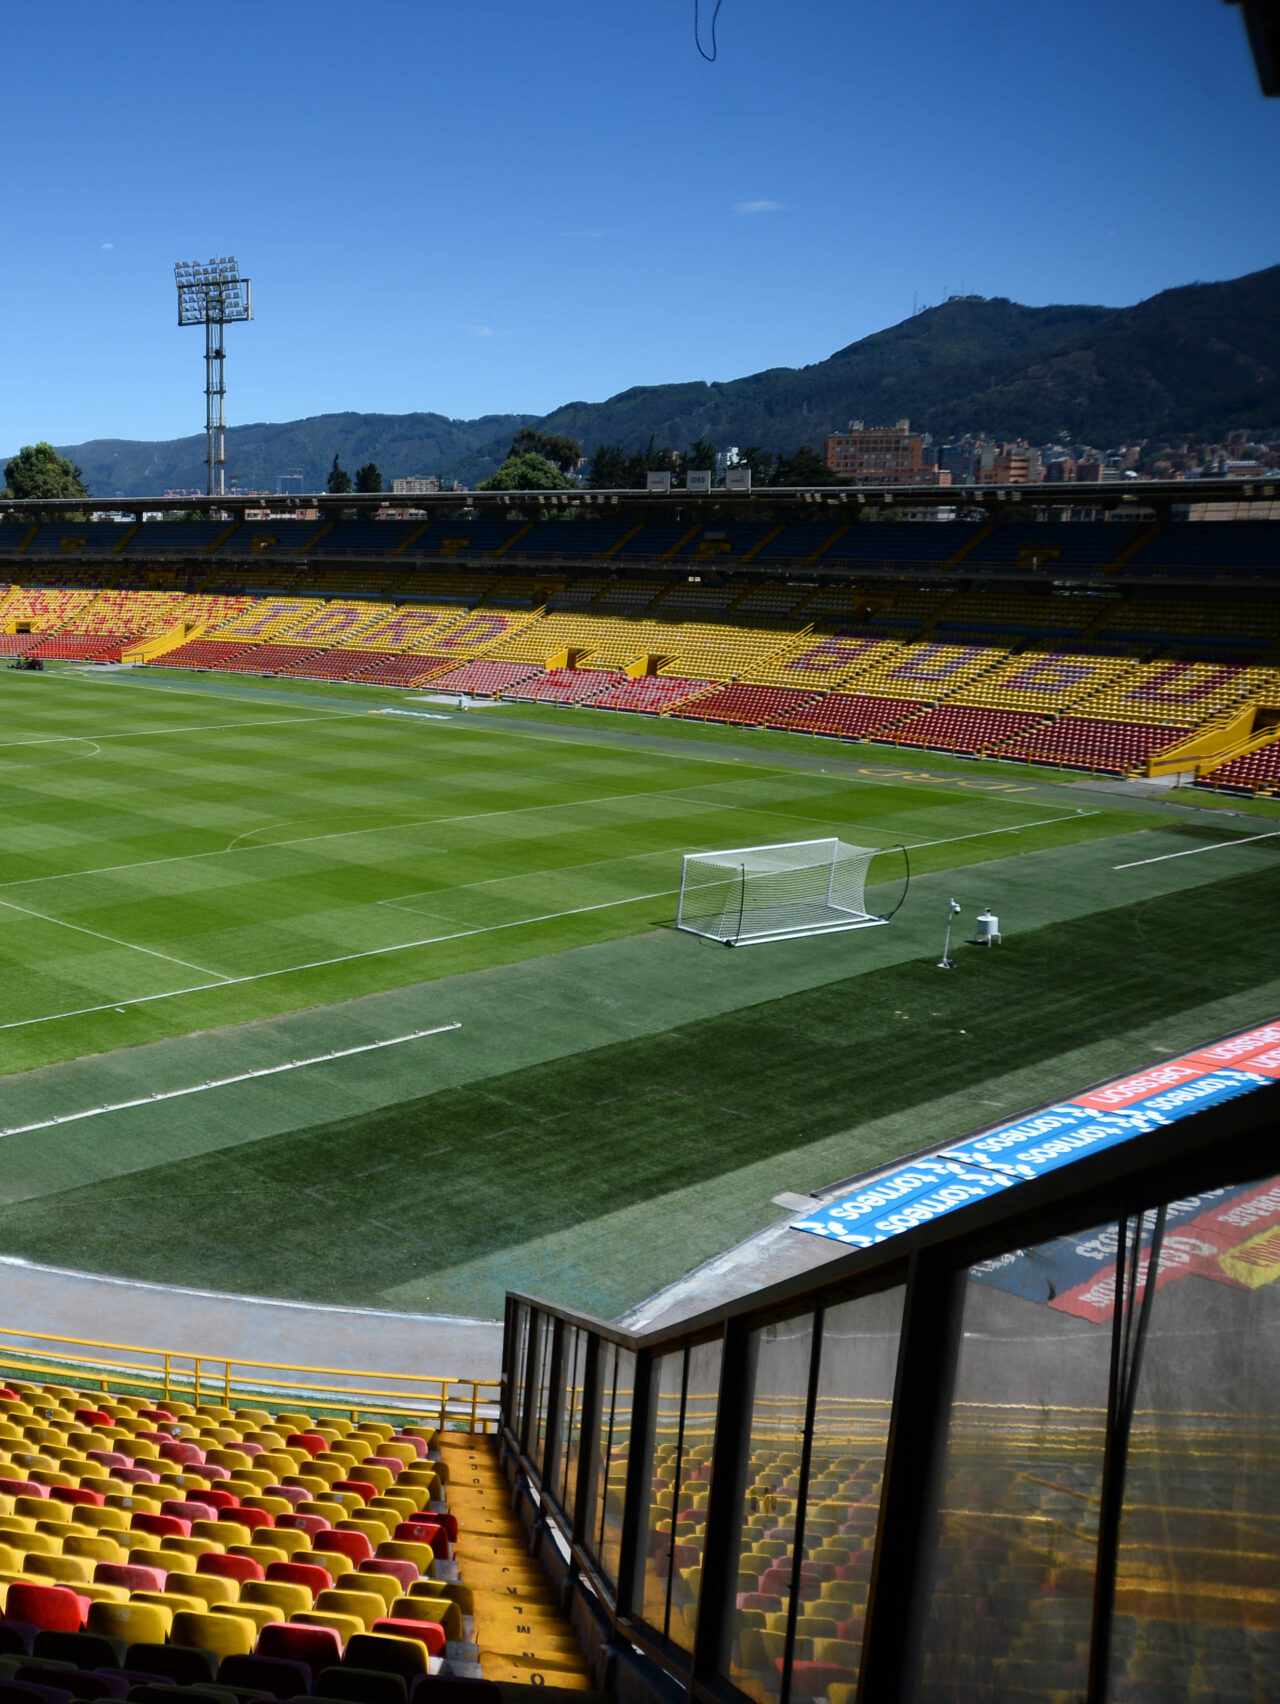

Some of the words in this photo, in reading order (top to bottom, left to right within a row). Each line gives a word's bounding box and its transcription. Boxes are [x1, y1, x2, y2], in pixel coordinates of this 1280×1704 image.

[231, 603, 511, 649] IDRD
[858, 767, 1037, 793] IDRD
[1089, 1065, 1205, 1104] betsson
[1143, 1078, 1243, 1110] torneos
[973, 1115, 1078, 1152] torneos
[1016, 1125, 1123, 1163] torneos
[829, 1172, 939, 1220] torneos
[875, 1185, 987, 1233] torneos
[513, 1606, 523, 1615] L
[516, 1625, 531, 1634] M
